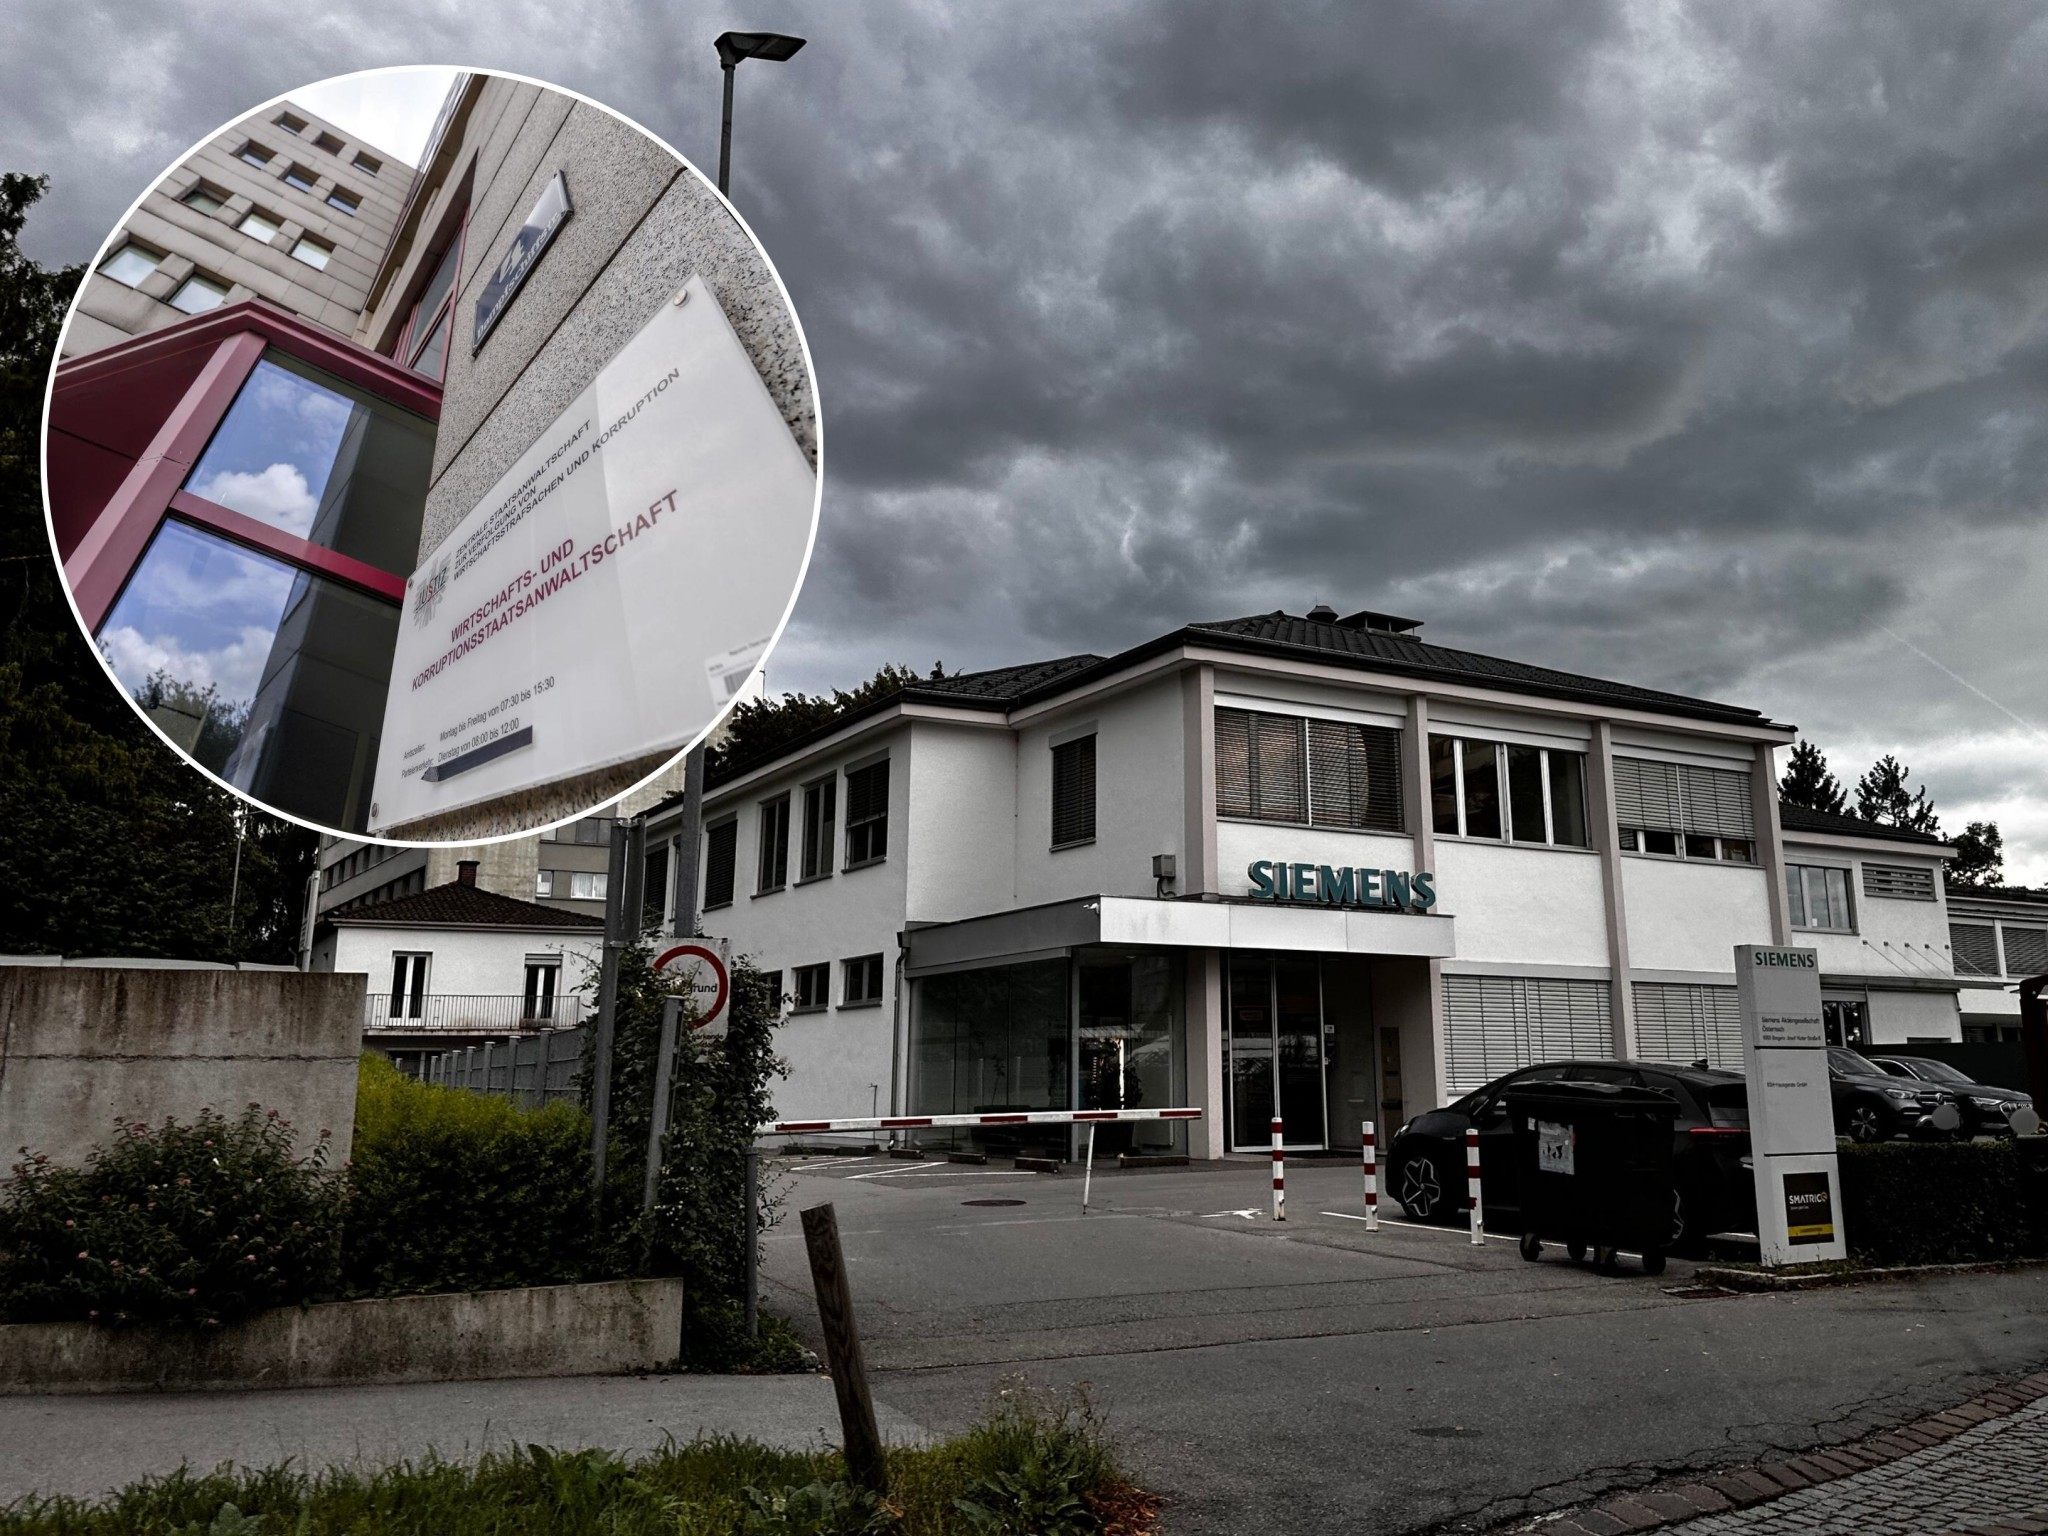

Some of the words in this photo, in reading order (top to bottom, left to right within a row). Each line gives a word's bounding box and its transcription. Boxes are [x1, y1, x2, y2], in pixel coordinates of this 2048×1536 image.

[454, 473, 564, 581] WIRTSCHAFTSSTRAFSACHEN
[566, 450, 590, 476] UND
[592, 368, 680, 453] KORRUPTION
[456, 519, 488, 558] ZENTRALE
[489, 419, 591, 525] STAATSANWALTSCHAFT
[455, 552, 468, 570] ZUR
[468, 505, 517, 556] VERFOLGUNG
[519, 486, 537, 508] VON
[412, 489, 678, 692] KORRUPTIONSSTAATSANWALTSCHAFT
[451, 570, 538, 643] WIRTSCHAFTS-
[541, 538, 574, 574] UND
[438, 745, 460, 763] Dienstag
[460, 741, 471, 752] von
[489, 727, 499, 740] bis
[500, 717, 520, 735] 12:00
[440, 725, 458, 742] Montag
[458, 721, 467, 732] bis
[467, 712, 487, 728] Freitag
[488, 706, 500, 717] von
[500, 693, 520, 712] 07:30
[520, 689, 532, 702] bis
[533, 676, 555, 695] 15:30
[1248, 860, 1437, 910] SIEMENS
[1755, 951, 1815, 968] SIEMENS
